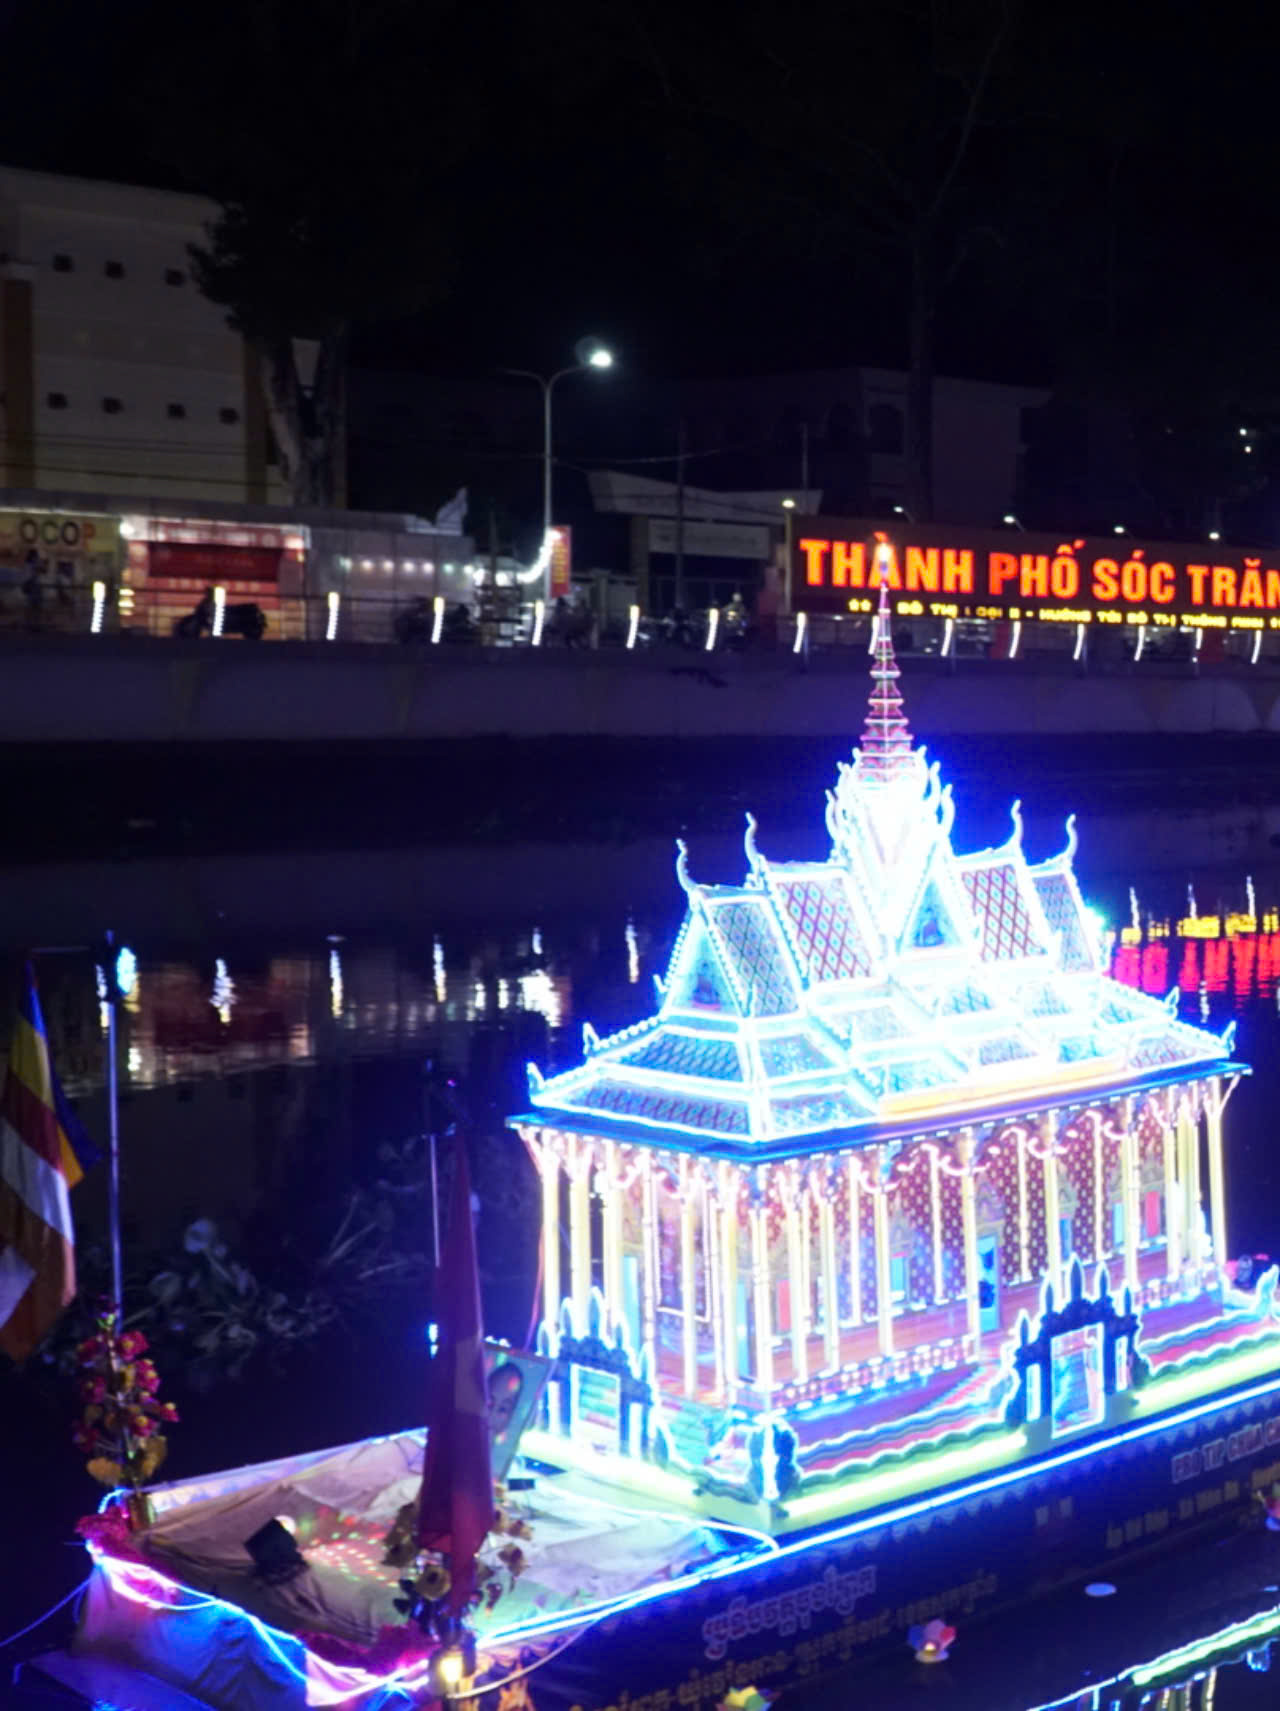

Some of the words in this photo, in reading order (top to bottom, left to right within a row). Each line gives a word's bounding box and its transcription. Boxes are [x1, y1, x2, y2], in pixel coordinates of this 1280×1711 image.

[19, 519, 96, 550] OCOP
[799, 531, 975, 594] THÀNH
[988, 540, 1085, 598] PHỐ
[1092, 549, 1176, 604] SÓC
